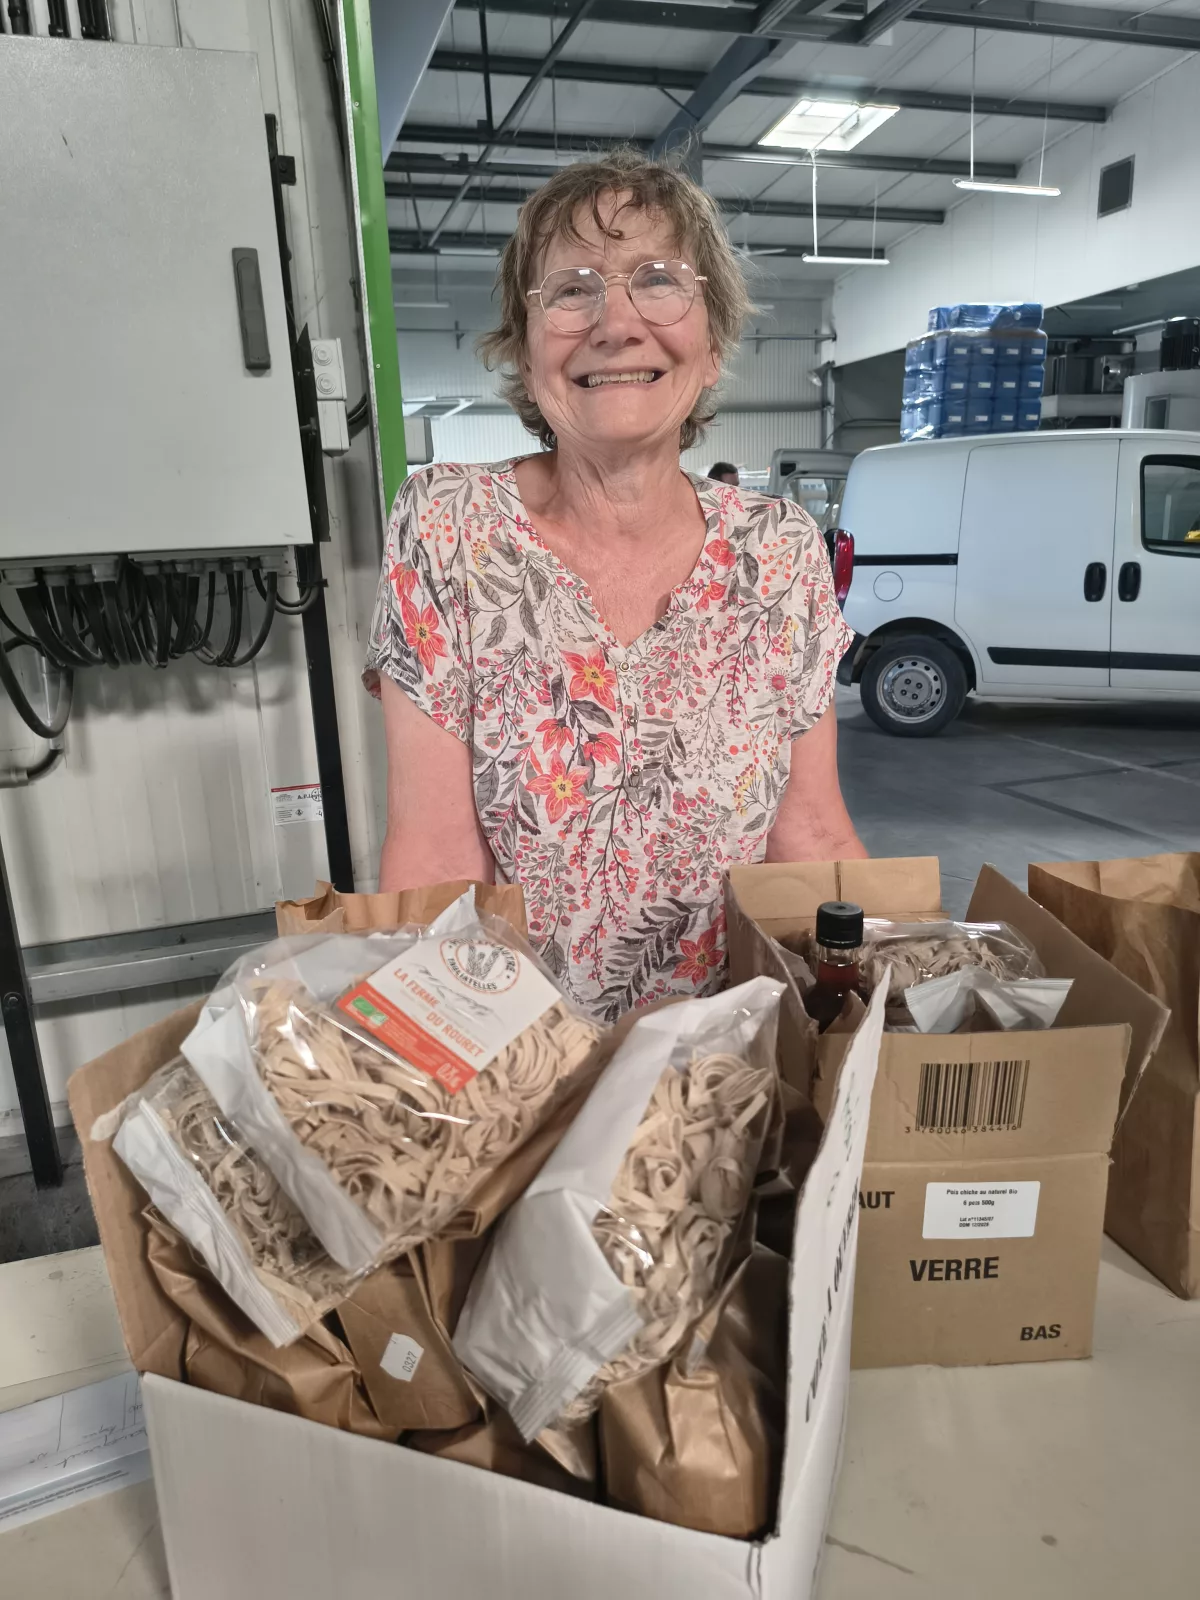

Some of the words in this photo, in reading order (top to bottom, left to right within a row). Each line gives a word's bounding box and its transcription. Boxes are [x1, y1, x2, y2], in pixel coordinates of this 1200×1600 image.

[447, 958, 498, 990] TAGLIATELLES
[394, 968, 408, 982] LA
[406, 980, 440, 1009] FERME
[426, 1011, 444, 1027] DU
[858, 1190, 896, 1210] AUT
[909, 1256, 1000, 1282] VERRE
[1019, 1324, 1062, 1342] BAS
[402, 1350, 417, 1373] 0327
